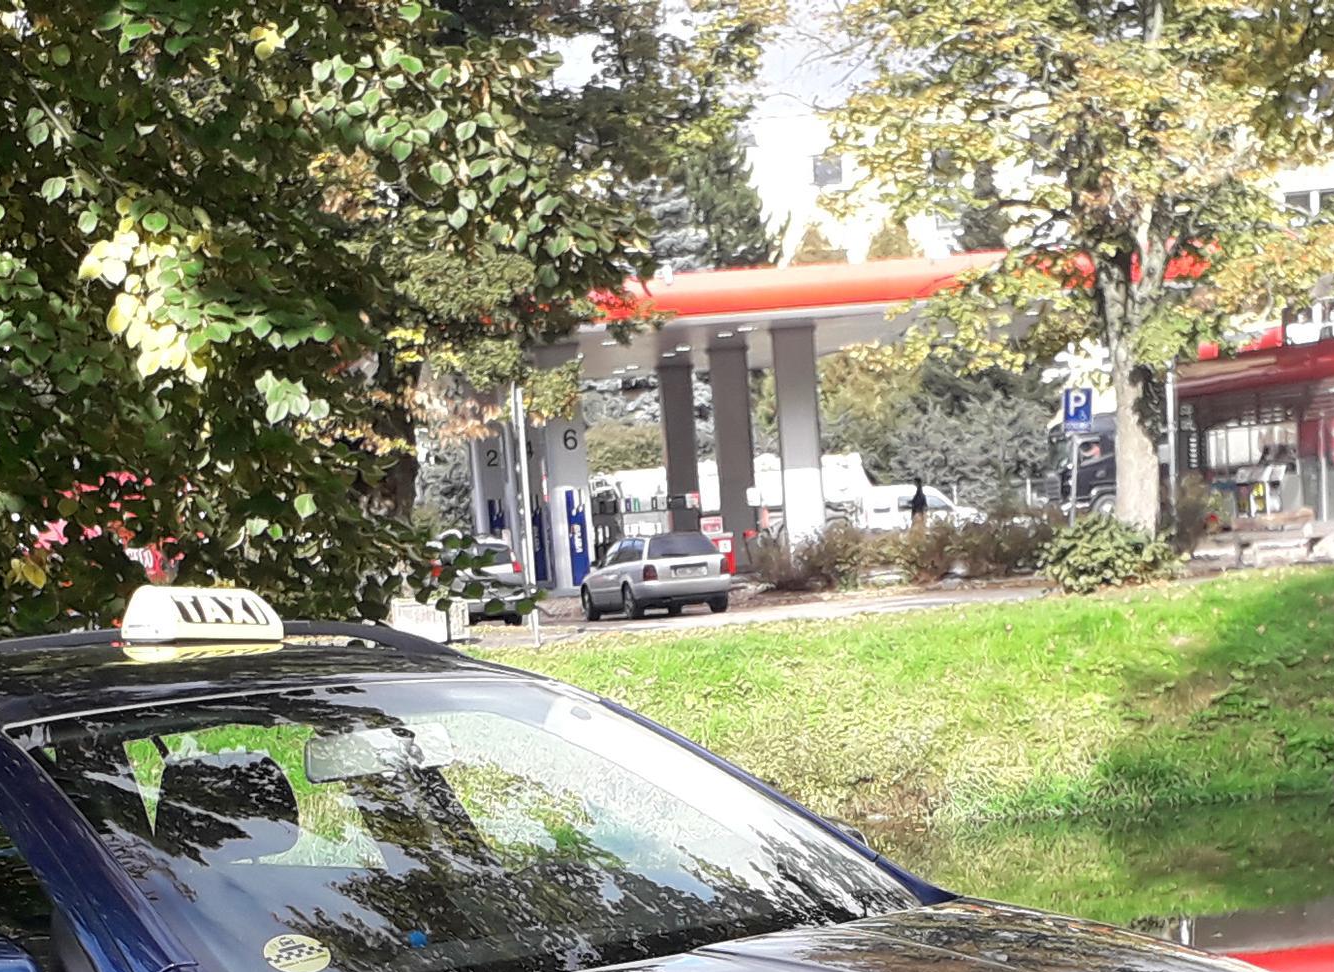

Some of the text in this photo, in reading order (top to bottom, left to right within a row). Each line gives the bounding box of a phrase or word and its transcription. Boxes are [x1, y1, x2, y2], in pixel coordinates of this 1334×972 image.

[1069, 390, 1086, 417] P
[563, 429, 578, 450] 6
[486, 450, 498, 467] 2
[171, 595, 269, 625] TAXI
